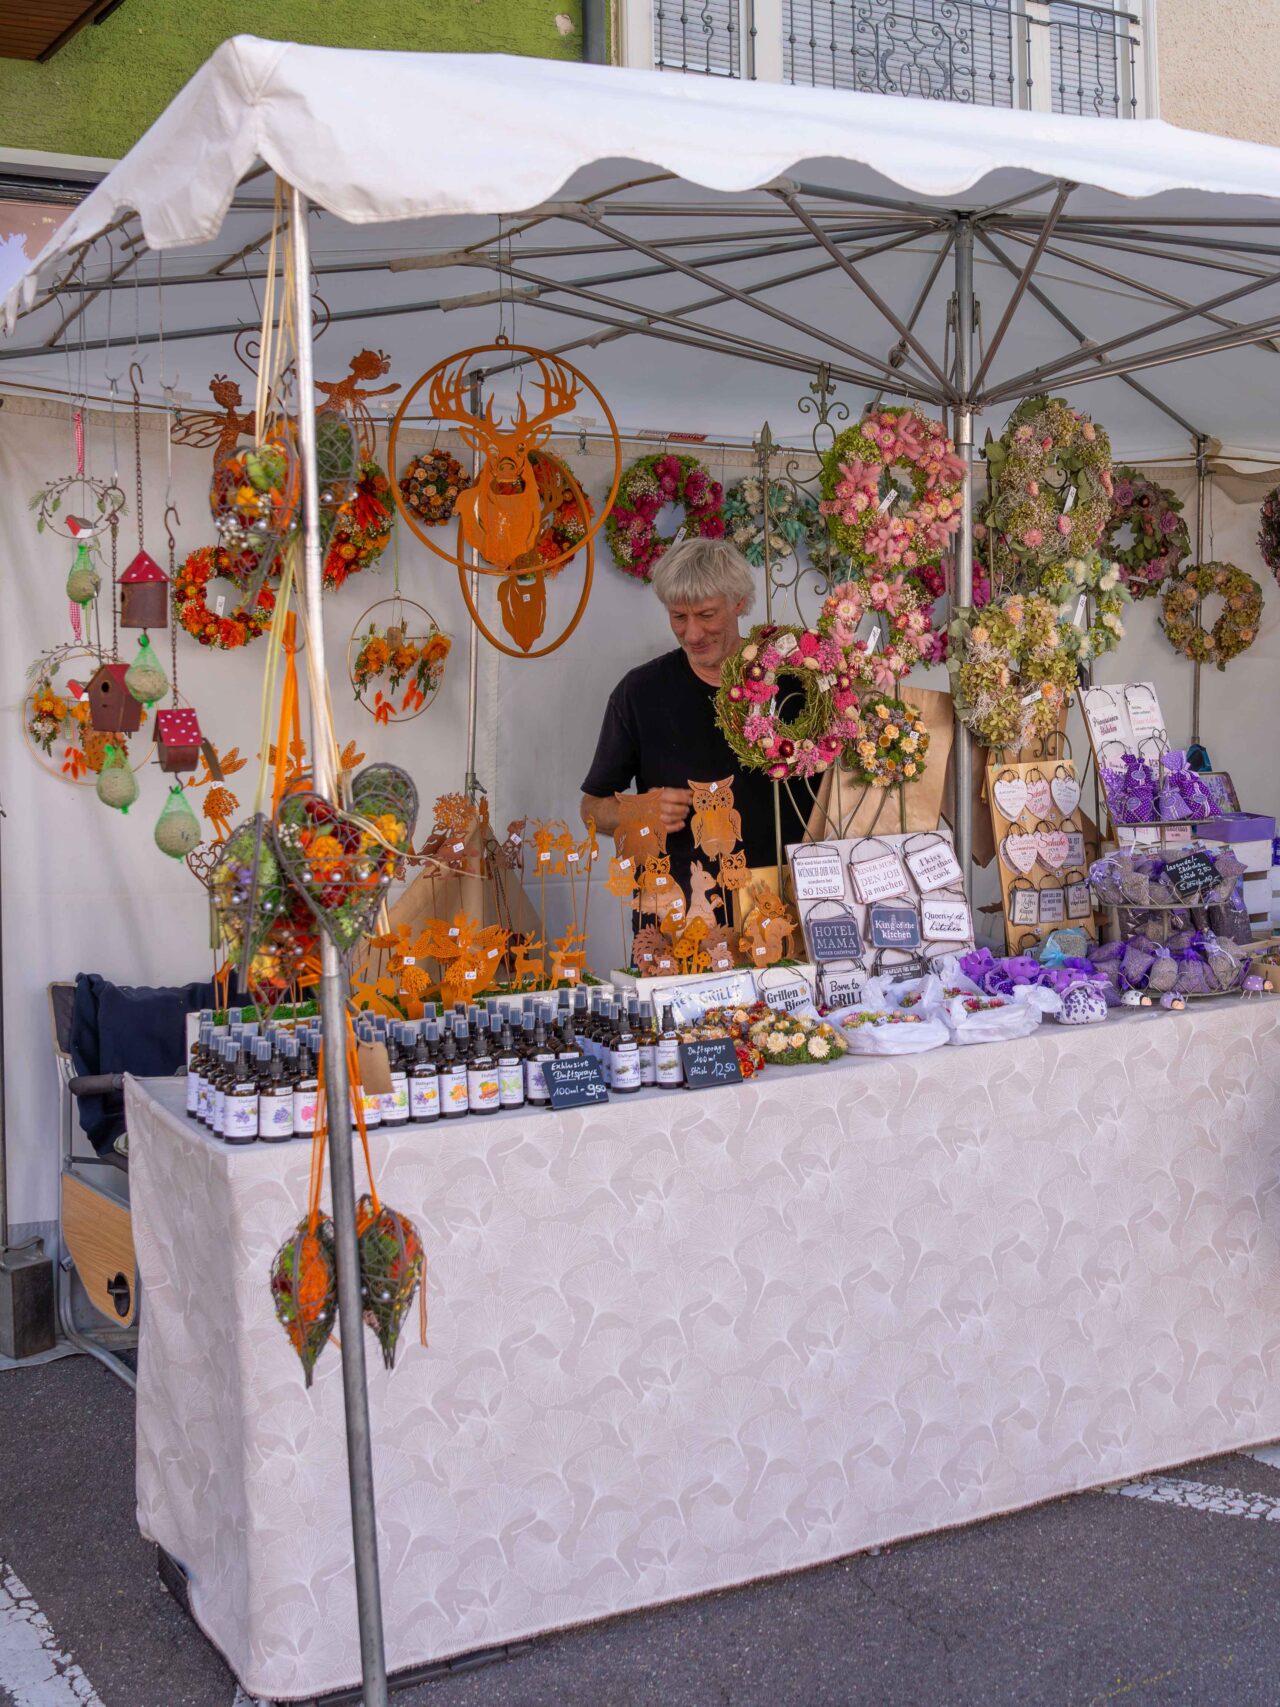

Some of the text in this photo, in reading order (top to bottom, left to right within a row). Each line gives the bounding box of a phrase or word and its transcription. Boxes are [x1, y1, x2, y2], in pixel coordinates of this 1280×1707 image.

[879, 860, 897, 871] MUSS
[925, 854, 942, 865] kiss
[915, 858, 953, 878] better than
[860, 869, 900, 887] DEN JOB
[932, 869, 951, 881] cook
[802, 885, 840, 896] SO ISSES!
[864, 880, 904, 898] ja machen
[924, 911, 946, 920] Queen
[946, 912, 954, 921] of
[875, 920, 895, 929] King
[896, 921, 904, 929] of
[929, 920, 963, 932] kitchen
[814, 925, 855, 937] HOTEL
[882, 930, 912, 939] kitchen
[817, 938, 857, 949] MAMA
[829, 978, 860, 993] Born to
[767, 988, 799, 1004] Grillen
